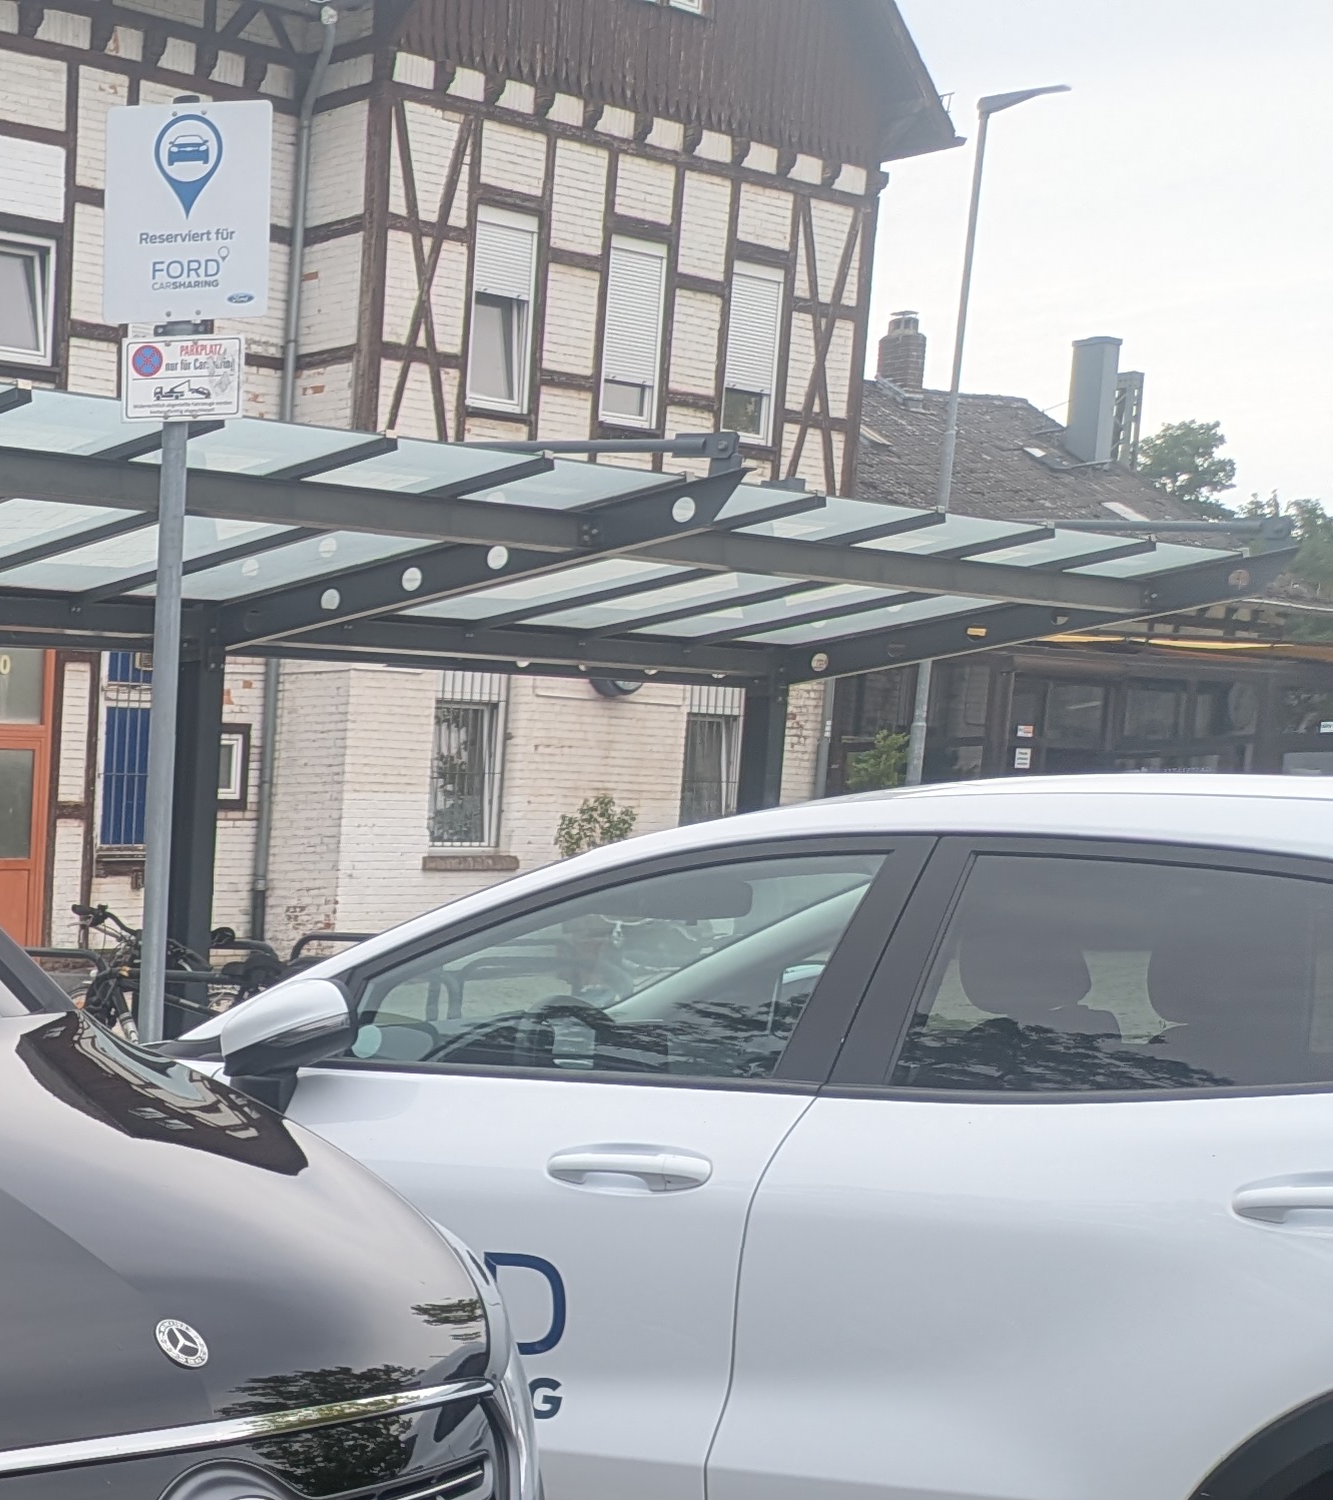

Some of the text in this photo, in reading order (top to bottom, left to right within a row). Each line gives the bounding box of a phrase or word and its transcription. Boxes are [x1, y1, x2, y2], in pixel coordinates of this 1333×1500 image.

[139, 228, 235, 244] Reserviert für
[152, 259, 220, 280] FORD
[151, 280, 219, 291] CARSHARING
[180, 344, 222, 356] PARKPLATZ
[165, 362, 178, 371] nur
[180, 358, 191, 371] für
